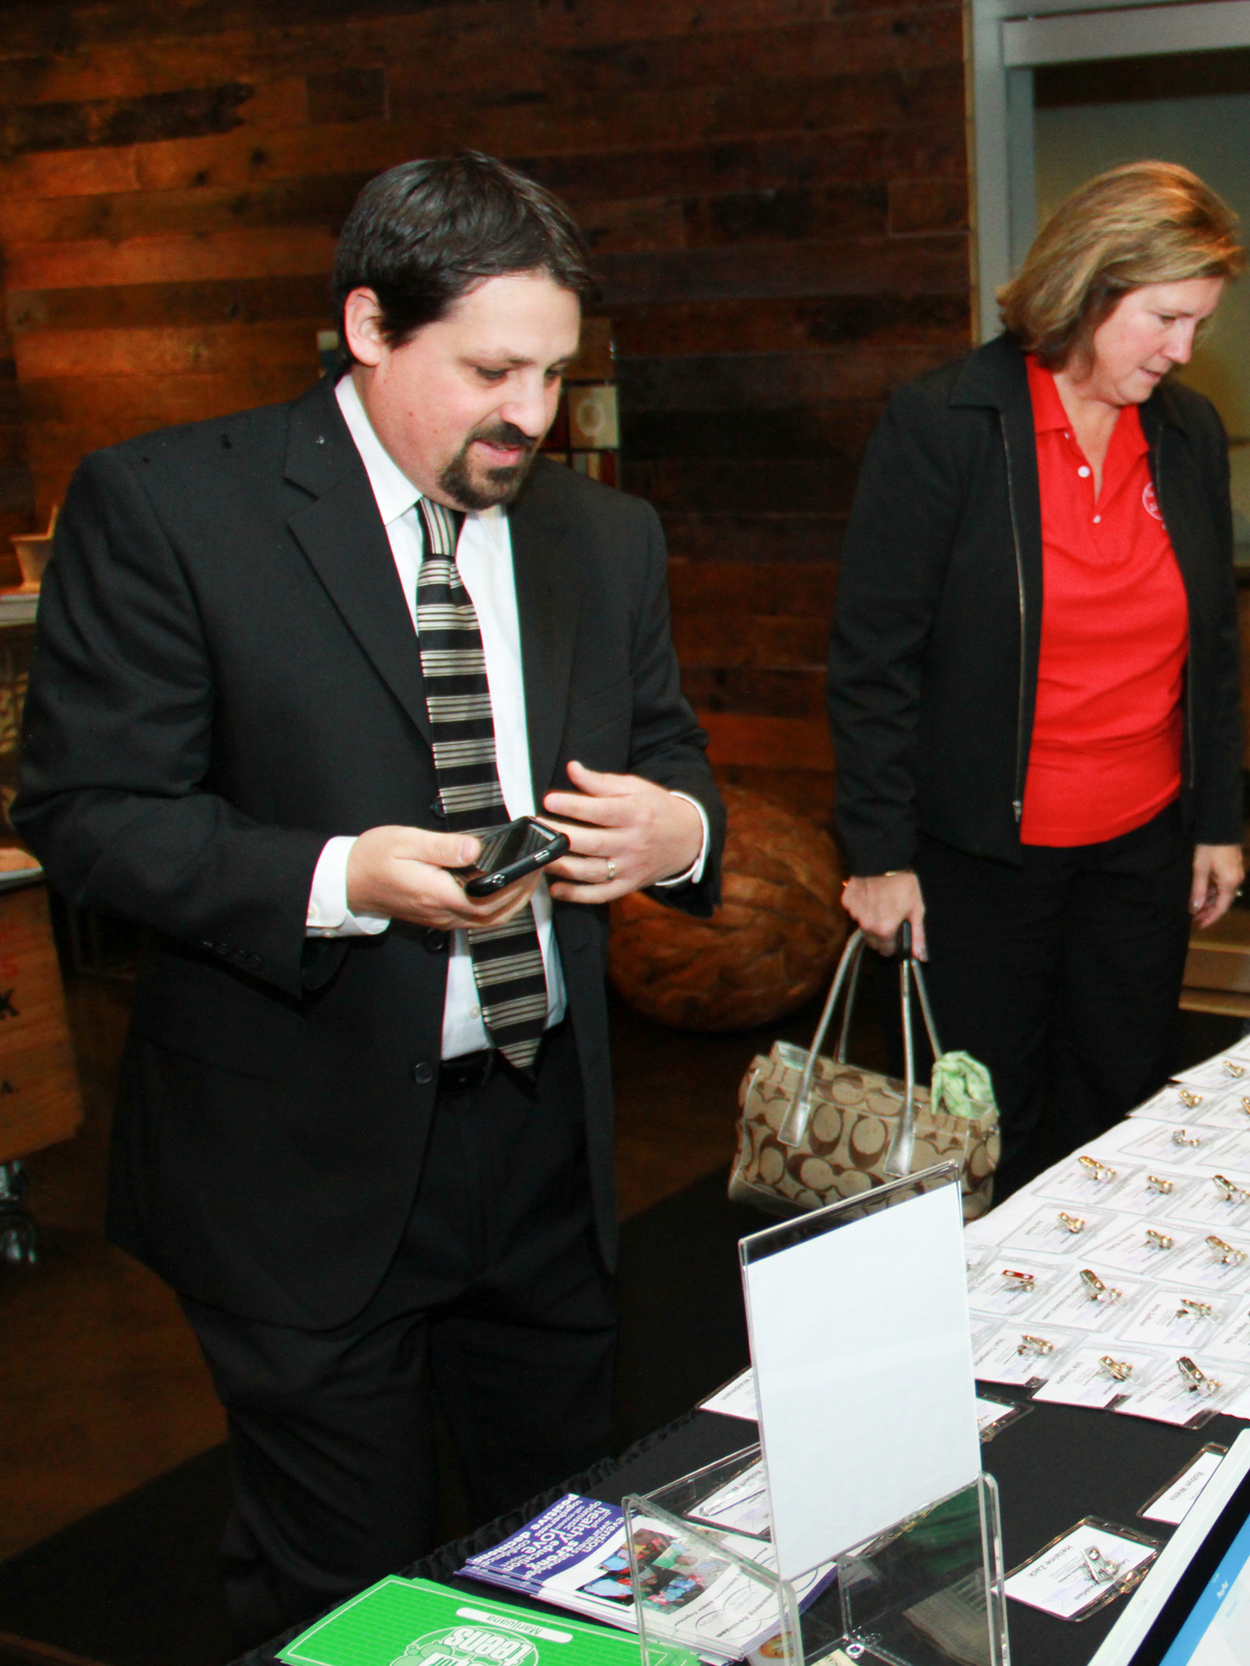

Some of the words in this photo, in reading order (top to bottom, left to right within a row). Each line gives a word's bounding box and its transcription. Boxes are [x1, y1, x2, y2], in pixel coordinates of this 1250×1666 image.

[527, 1492, 581, 1531] positive
[553, 1506, 612, 1544] healthy
[561, 1499, 604, 1531] optimistic
[469, 1530, 534, 1565] decisions
[501, 1539, 563, 1571] education
[518, 1528, 567, 1555] love
[524, 1539, 580, 1571] strong
[486, 1614, 543, 1635] Marijuana
[443, 1627, 535, 1664] teens
